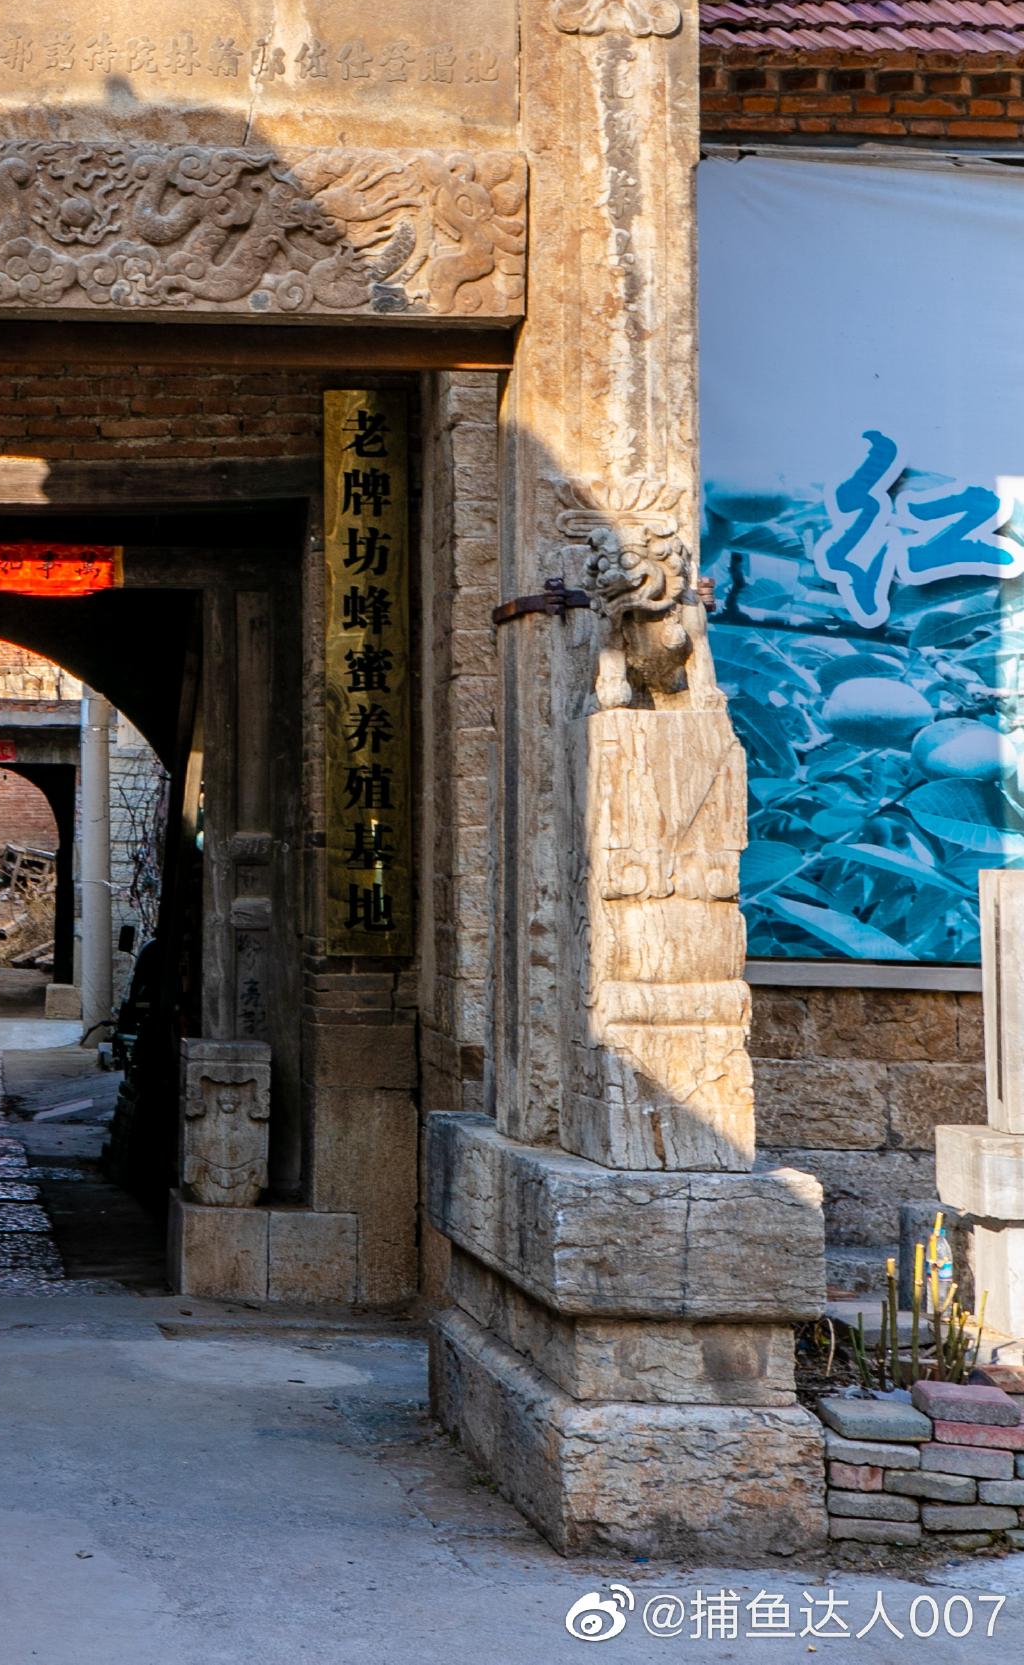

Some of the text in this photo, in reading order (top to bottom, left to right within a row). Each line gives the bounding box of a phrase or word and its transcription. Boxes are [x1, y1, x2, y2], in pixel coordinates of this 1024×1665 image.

[341, 409, 396, 933] 老牌坊蜂蜜养殖基地
[821, 429, 1018, 624] 红
